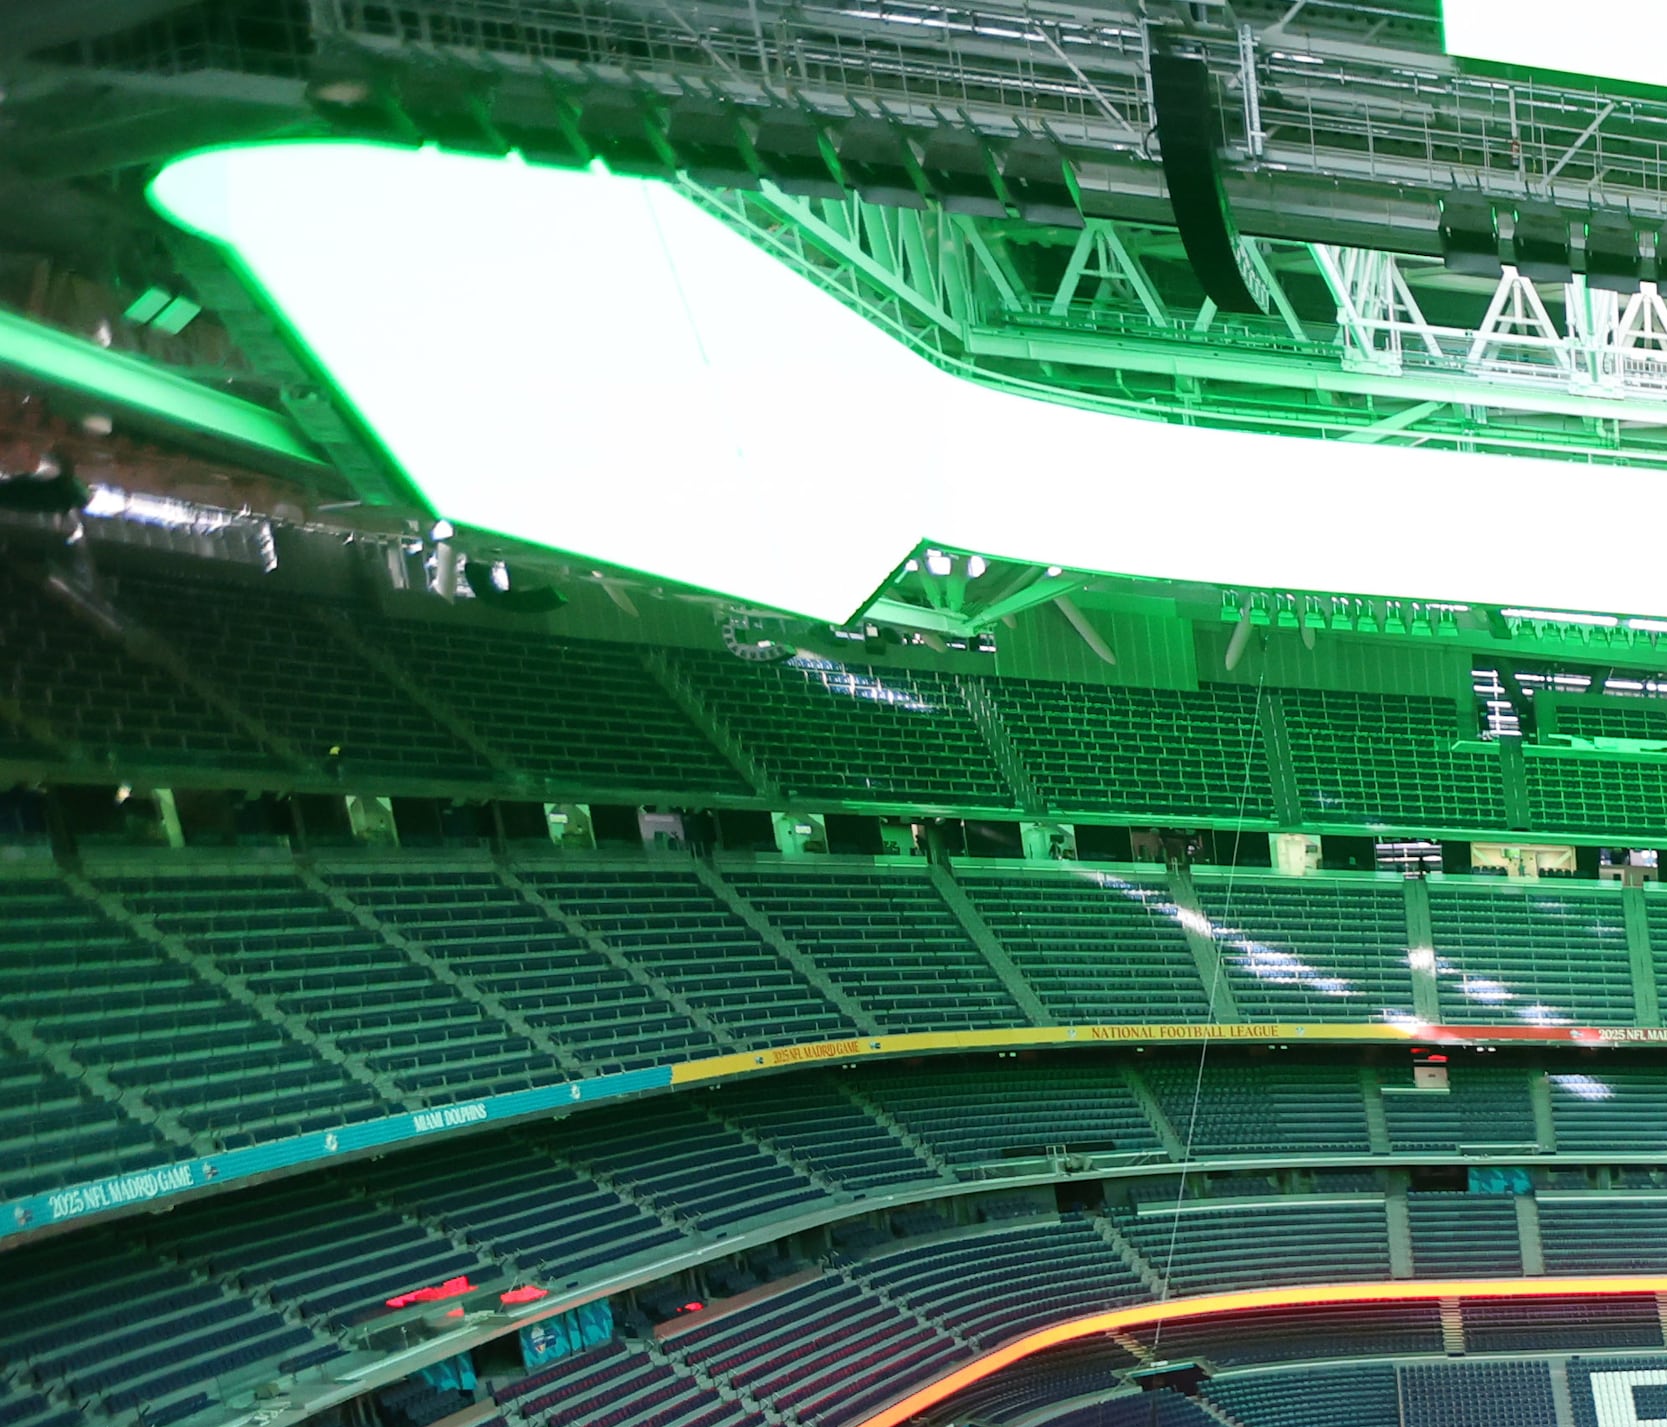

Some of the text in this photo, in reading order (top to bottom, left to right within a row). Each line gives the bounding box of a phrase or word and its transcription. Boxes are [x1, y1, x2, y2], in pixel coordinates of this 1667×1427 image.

[1092, 1025, 1279, 1039] NATIONAL FOOTBALL LEAGUE
[1599, 1029, 1625, 1041] 2025
[1626, 1030, 1646, 1041] NFL
[803, 1043, 837, 1058] MADRID
[837, 1041, 859, 1054] GAME
[413, 1103, 487, 1133] MIAMI DOLPHINS
[49, 1165, 194, 1219] 2025 NFL MADRID GAME
